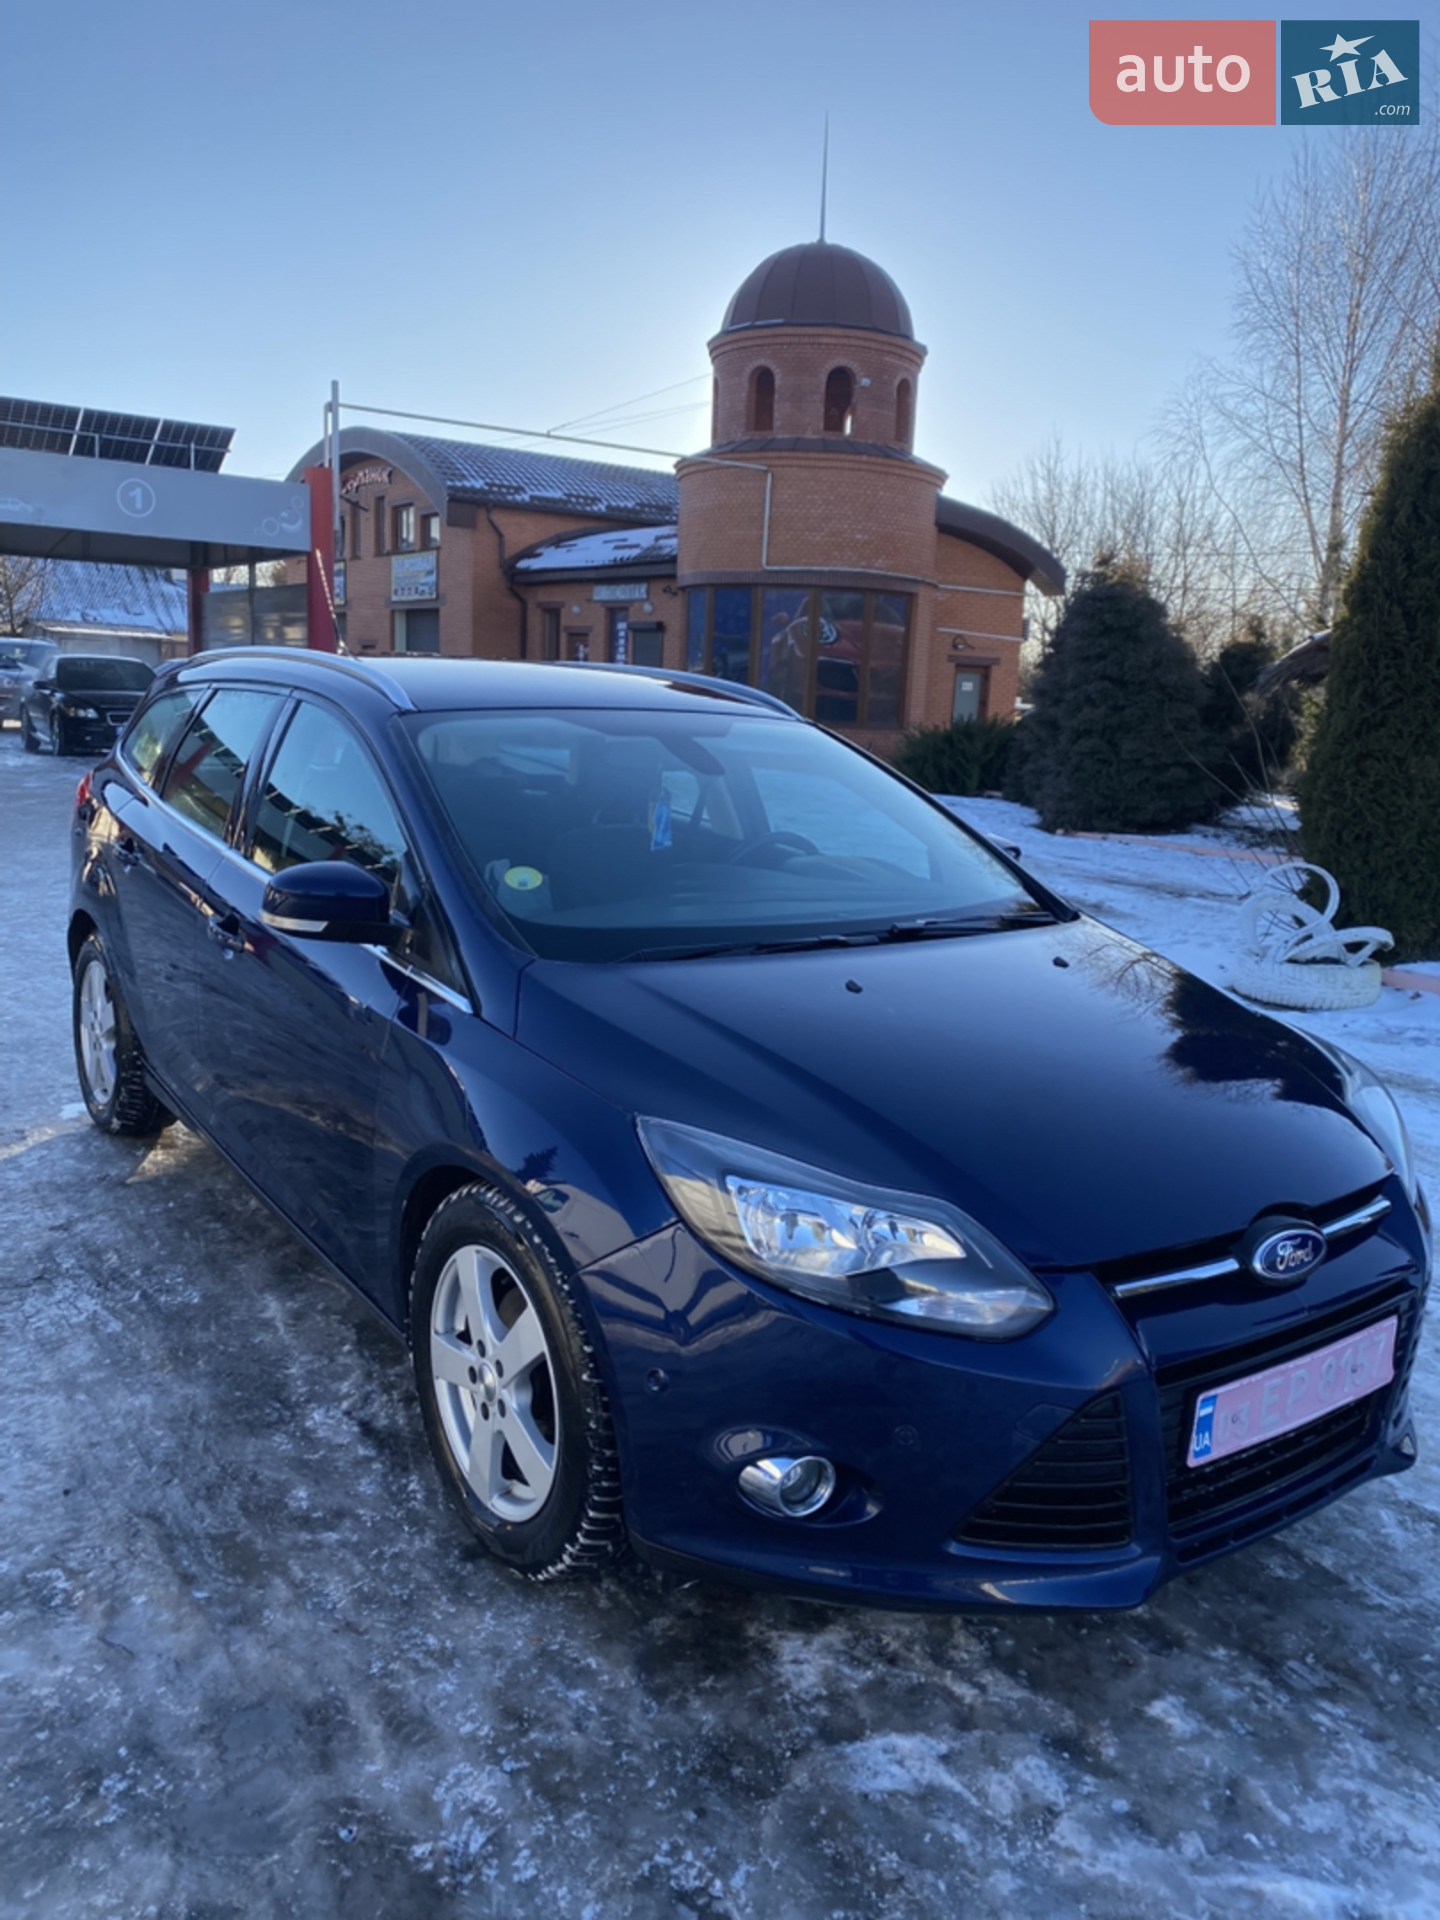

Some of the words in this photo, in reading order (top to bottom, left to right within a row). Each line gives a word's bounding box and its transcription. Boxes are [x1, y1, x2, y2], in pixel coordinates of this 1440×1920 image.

[129, 487, 143, 510] 1
[1275, 1237, 1315, 1271] Ford
[1194, 1426, 1212, 1452] UA
